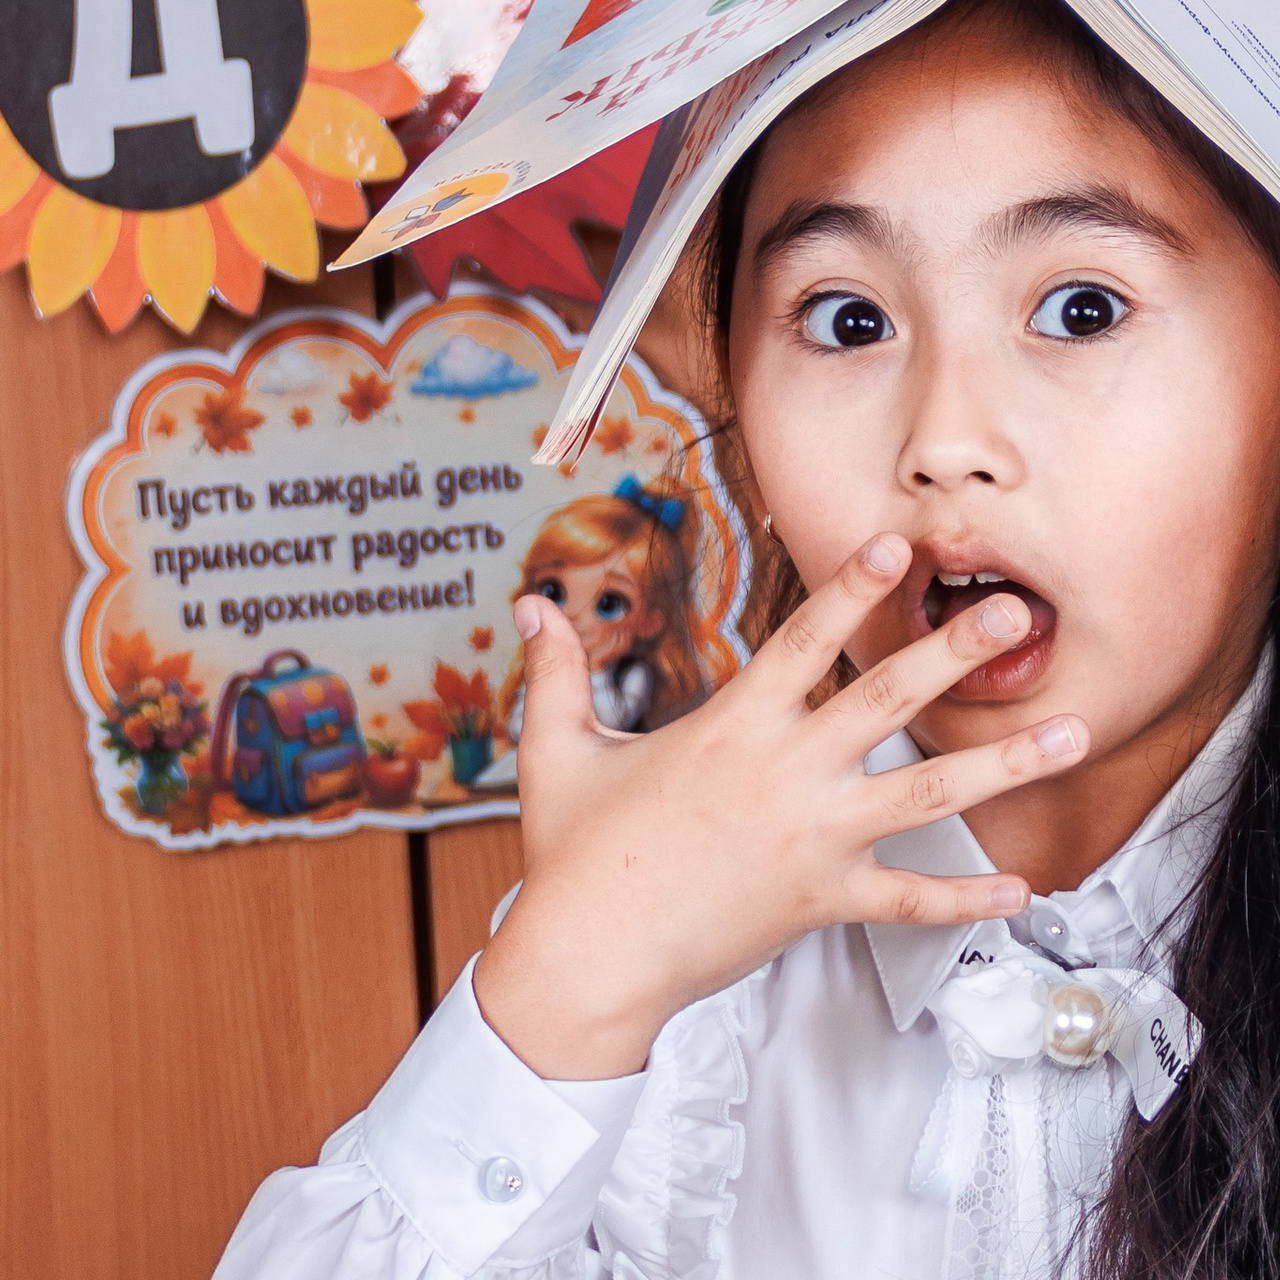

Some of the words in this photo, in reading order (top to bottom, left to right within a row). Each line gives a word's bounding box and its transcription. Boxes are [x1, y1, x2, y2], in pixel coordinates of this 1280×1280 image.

[136, 478, 254, 531] Пусть
[268, 463, 423, 516] каждый
[435, 458, 525, 511] день
[154, 532, 337, 586] приносит
[352, 521, 506, 572] радость
[182, 599, 206, 631] и
[219, 569, 477, 635] вдохновение!
[1149, 1017, 1191, 1086] CHANE
